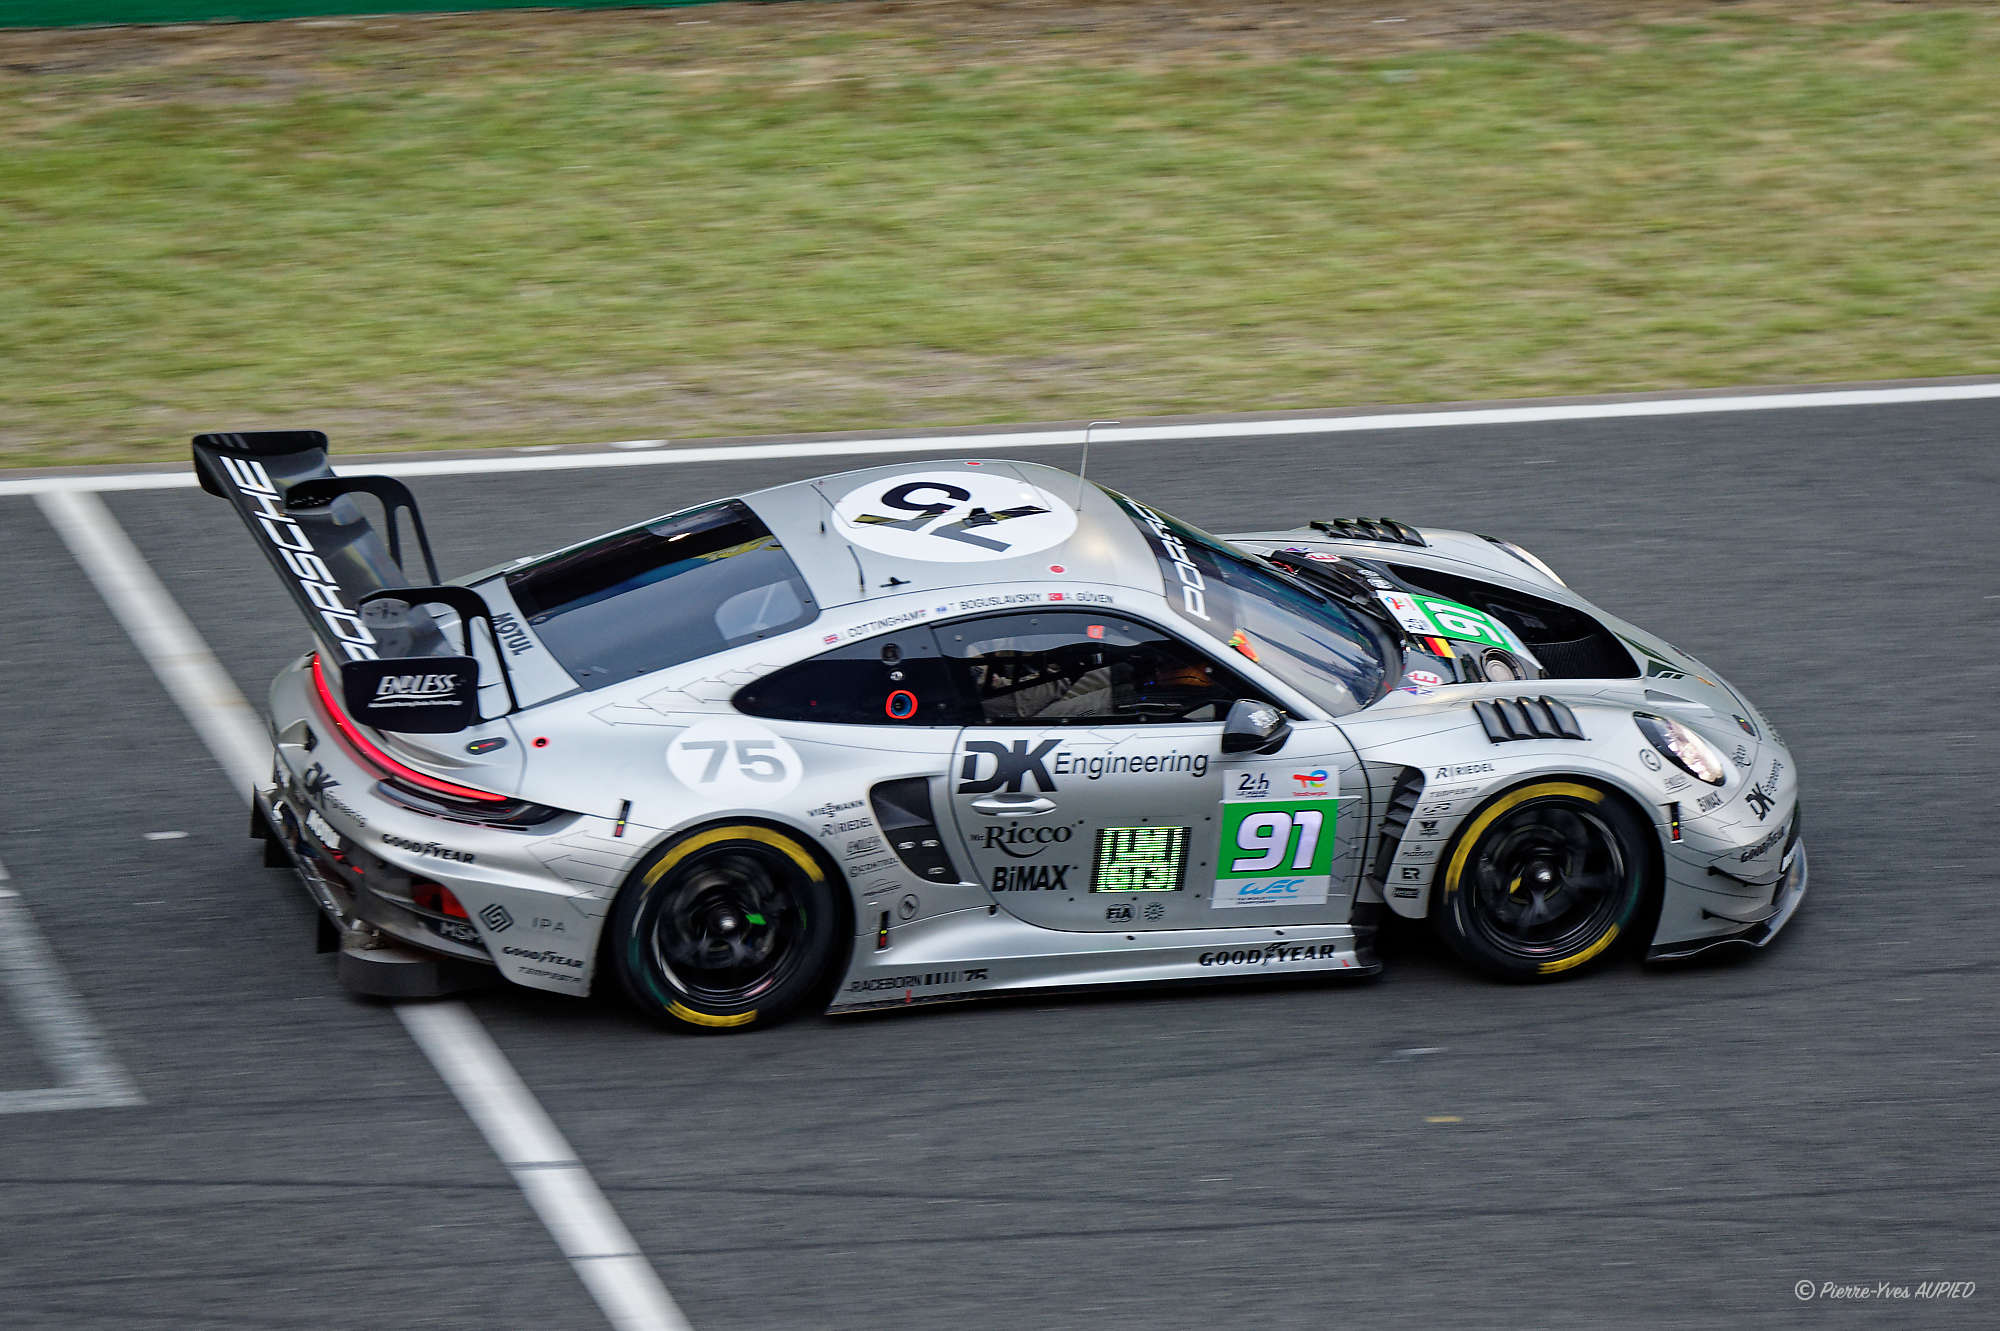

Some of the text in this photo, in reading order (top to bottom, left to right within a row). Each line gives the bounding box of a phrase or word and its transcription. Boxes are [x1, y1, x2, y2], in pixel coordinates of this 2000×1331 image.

[490, 612, 533, 656] MOTUL
[1423, 601, 1505, 645] 91
[680, 740, 787, 783] 75
[957, 739, 1209, 794] DK Engineering
[1456, 763, 1495, 776] RIEDEL
[1744, 782, 1776, 821] DK
[383, 833, 475, 864] GOODYEAR
[982, 821, 1073, 858] Ricco
[1230, 810, 1324, 873] 91
[992, 864, 1070, 892] BiMAX
[1237, 879, 1304, 895] WEC
[1106, 906, 1133, 920] FIA
[503, 946, 585, 969] GOODYEAR
[1200, 942, 1335, 966] GOODYEAR
